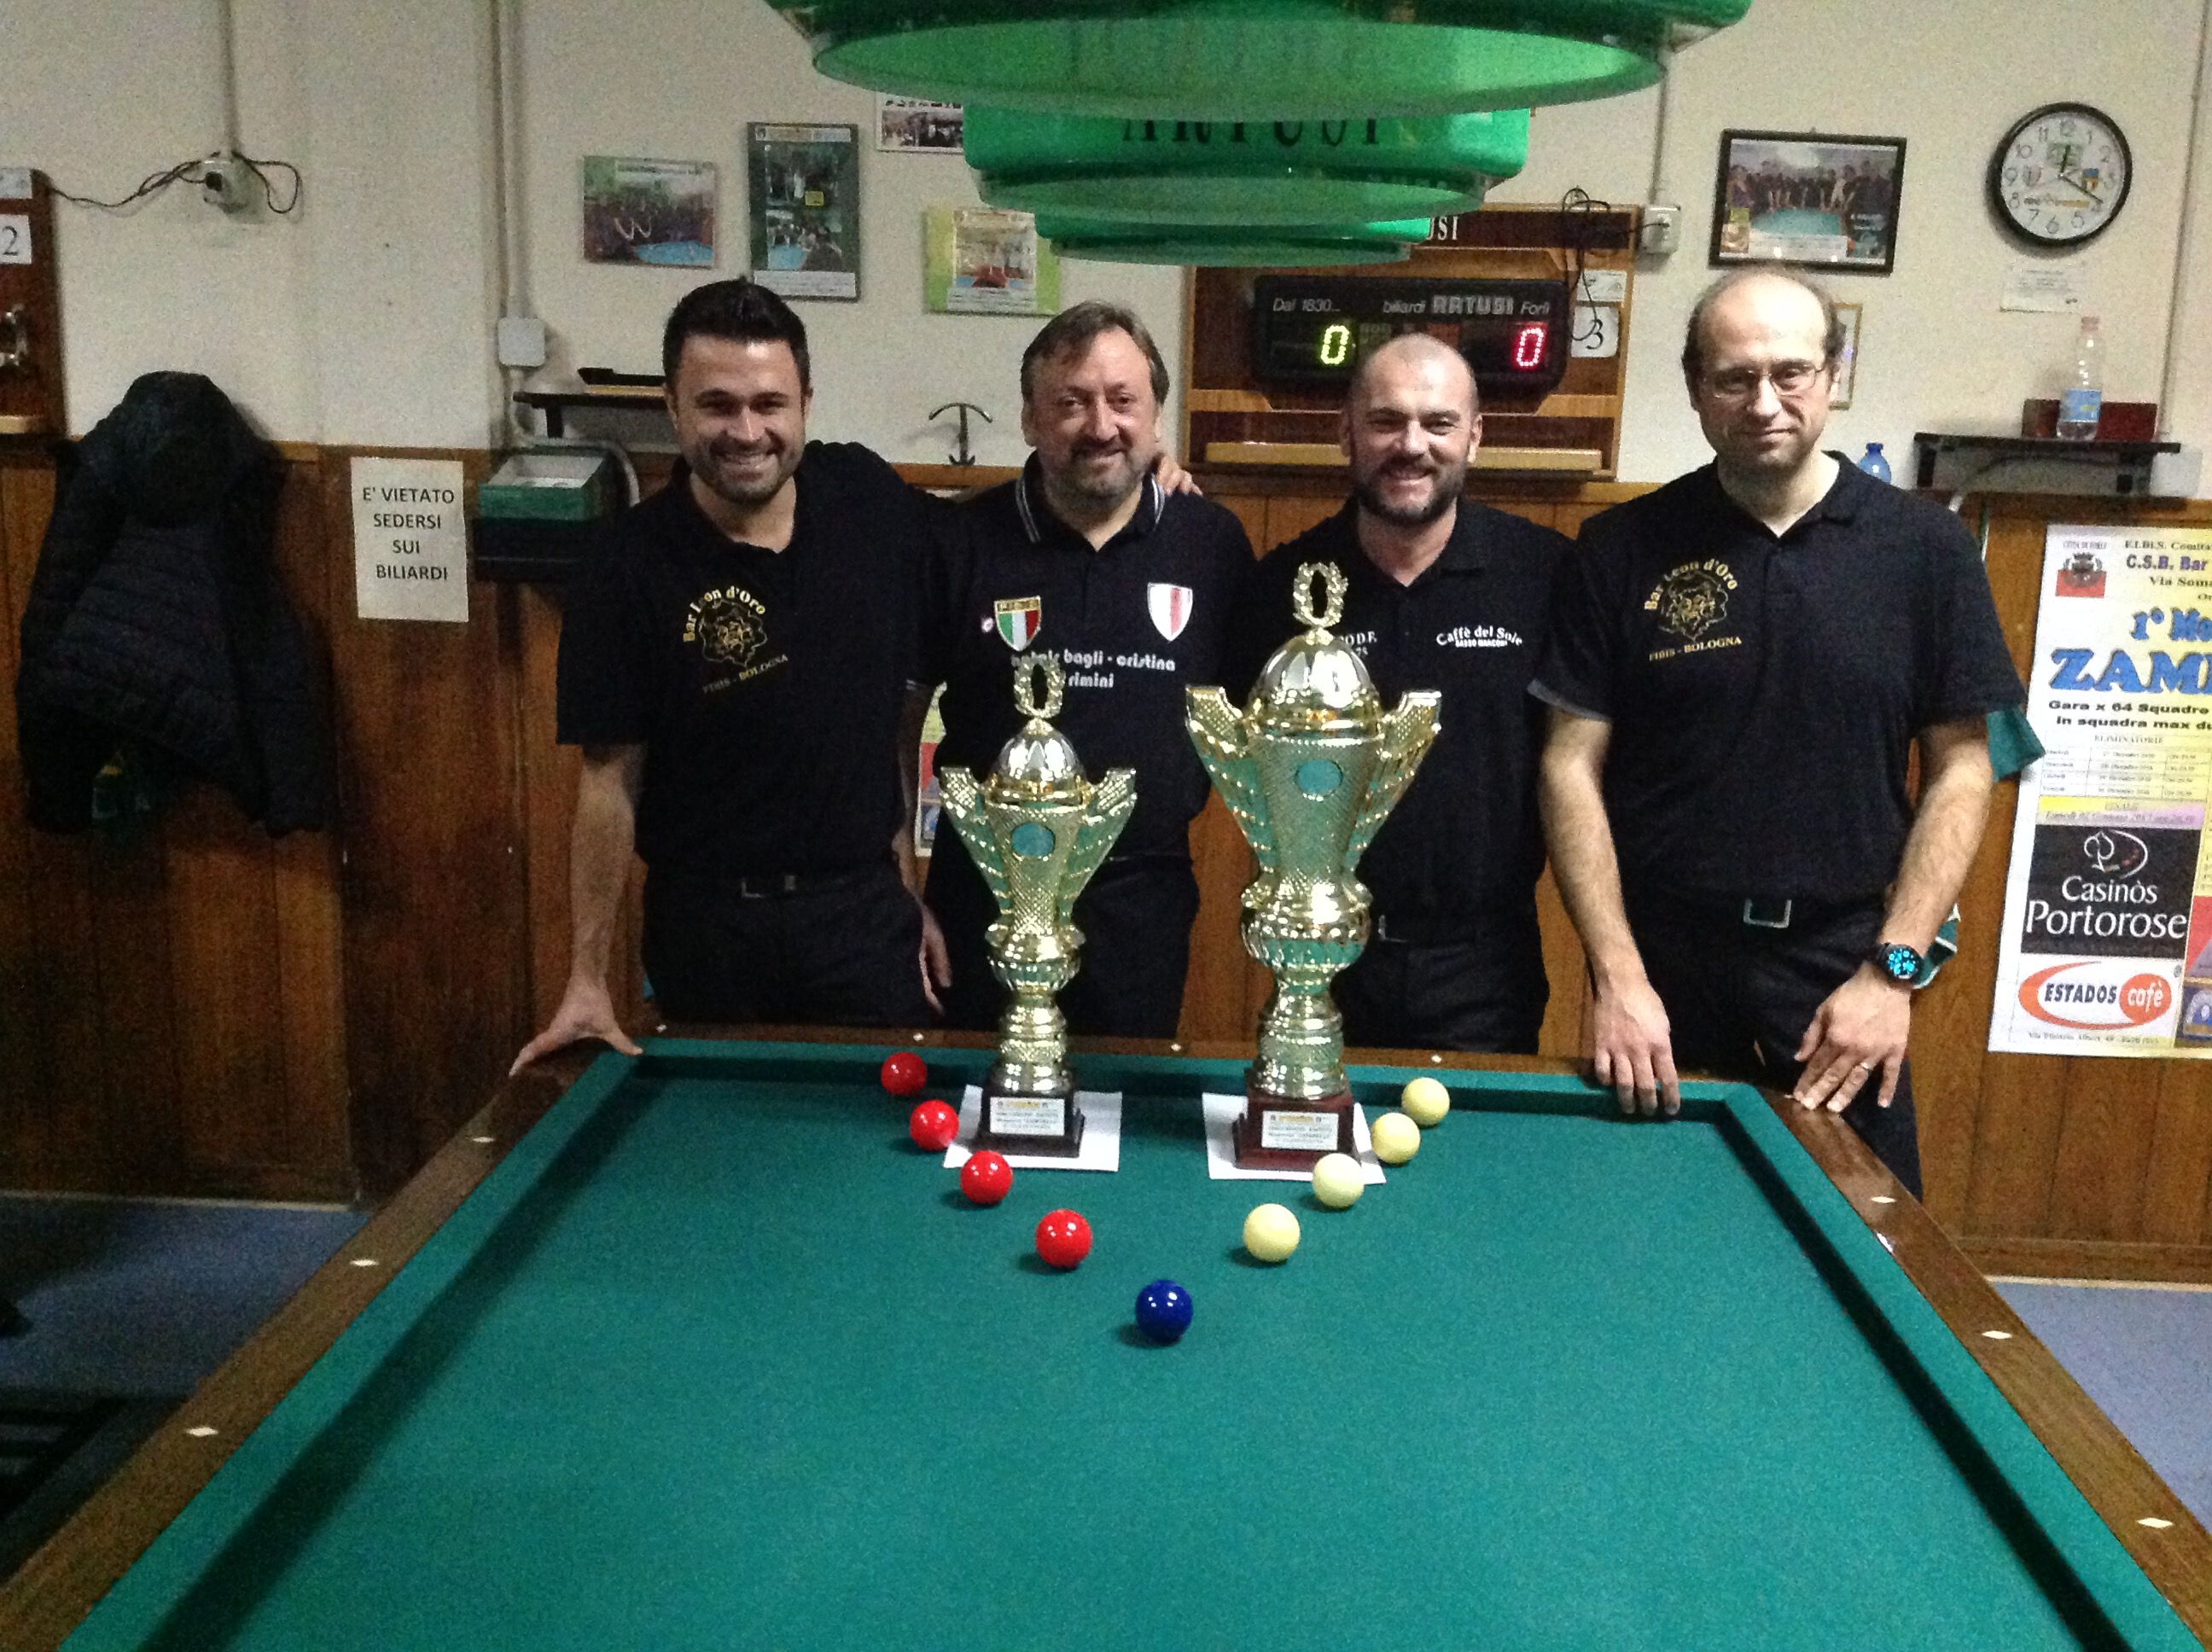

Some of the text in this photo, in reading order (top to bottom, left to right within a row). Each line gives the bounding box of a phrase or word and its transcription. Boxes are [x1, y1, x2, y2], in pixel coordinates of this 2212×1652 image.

[2005, 167, 2018, 186] 9
[2009, 191, 2020, 209] 8
[2028, 207, 2040, 225] 7
[2046, 213, 2059, 235] 6
[2, 225, 19, 255] 2
[1272, 298, 1296, 312] Dal
[1320, 324, 1350, 365] 0
[1516, 327, 1545, 367] 0
[381, 487, 454, 503] VIETATO
[373, 513, 441, 530] SEDERSI
[393, 539, 420, 554] SUI
[2170, 540, 2212, 550] Comita
[2126, 554, 2209, 572] C.S.B. Bar
[375, 564, 447, 581] BILIARDI
[2149, 577, 2172, 586] Via
[1474, 625, 1493, 638] del
[1496, 626, 1523, 647] Sole
[1684, 636, 1742, 654] BOLOGNA
[1063, 649, 1103, 668] bagli
[1116, 653, 1175, 672] cristina
[1068, 672, 1114, 689] rimini
[2048, 700, 2090, 711] Gara
[2095, 702, 2105, 711] x
[2111, 702, 2133, 712] 64
[2077, 718, 2148, 728] squadra
[2152, 720, 2191, 730] max
[2061, 875, 2158, 905] Casinòs
[2025, 899, 2188, 939] Portorose
[2044, 980, 2165, 1013] ESTADOS cafè
